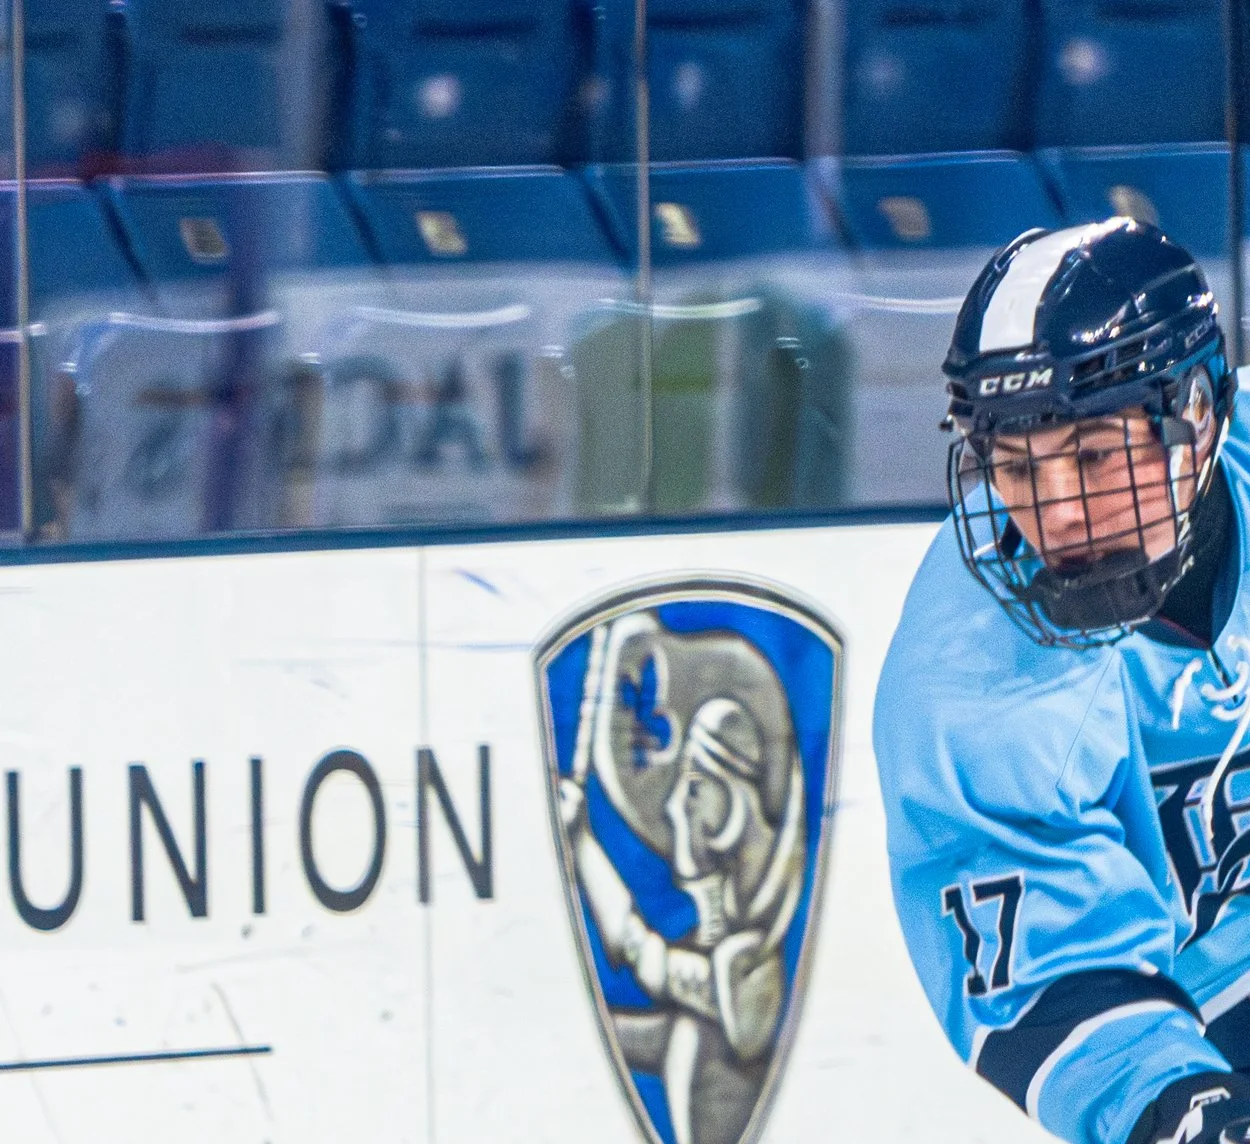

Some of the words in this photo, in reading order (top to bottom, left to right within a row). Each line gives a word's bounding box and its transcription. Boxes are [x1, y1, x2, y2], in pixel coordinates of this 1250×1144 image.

[979, 367, 1054, 396] CCM
[5, 743, 494, 932] UNION
[941, 872, 1024, 998] 17
